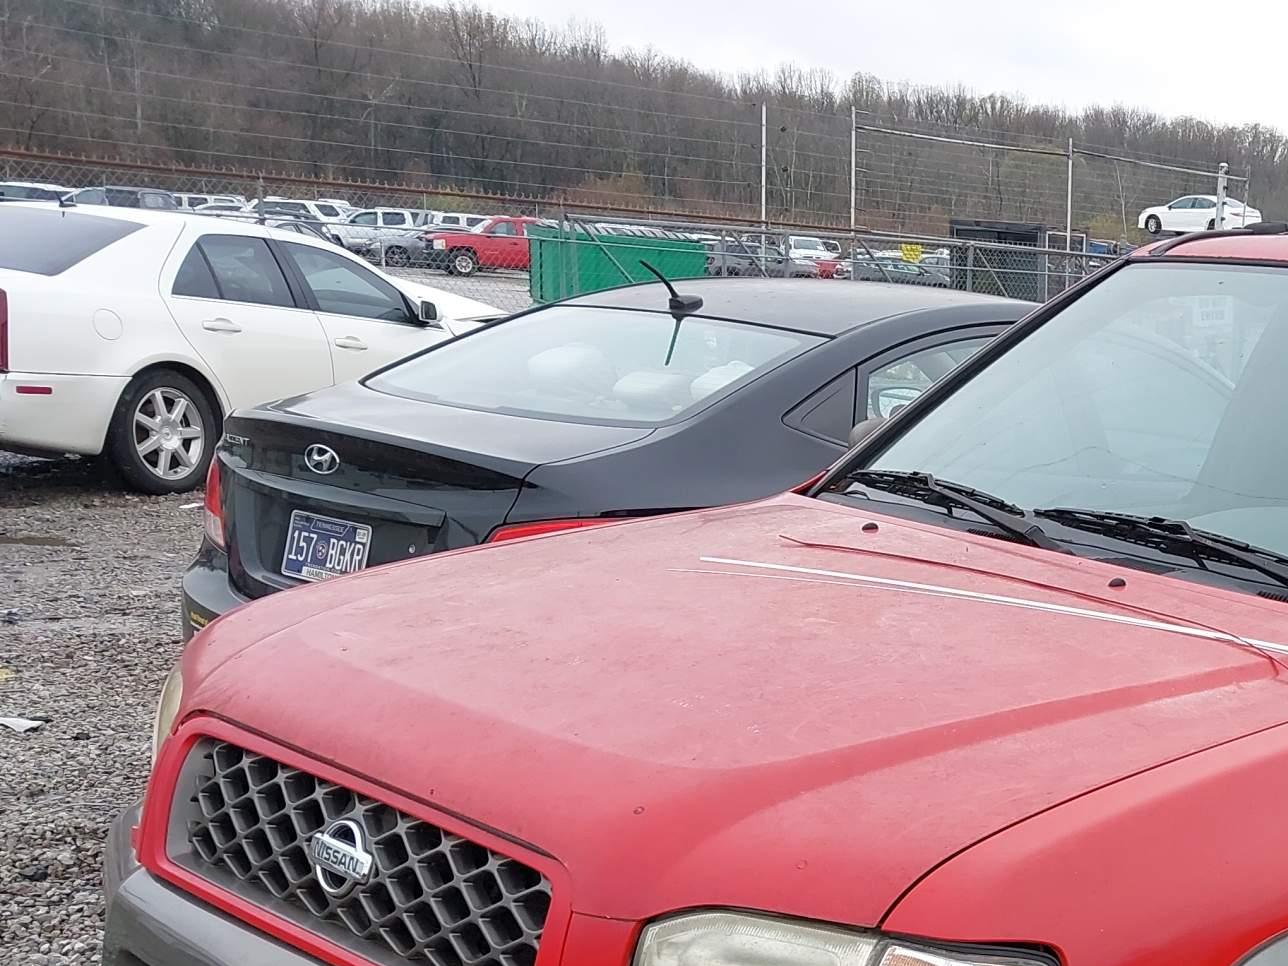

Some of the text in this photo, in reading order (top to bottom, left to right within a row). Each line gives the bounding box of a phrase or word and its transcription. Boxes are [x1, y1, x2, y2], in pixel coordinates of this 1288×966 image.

[315, 519, 345, 533] TENNESSEE
[287, 529, 364, 574] 157 BGKR
[313, 837, 360, 872] NISSAN
